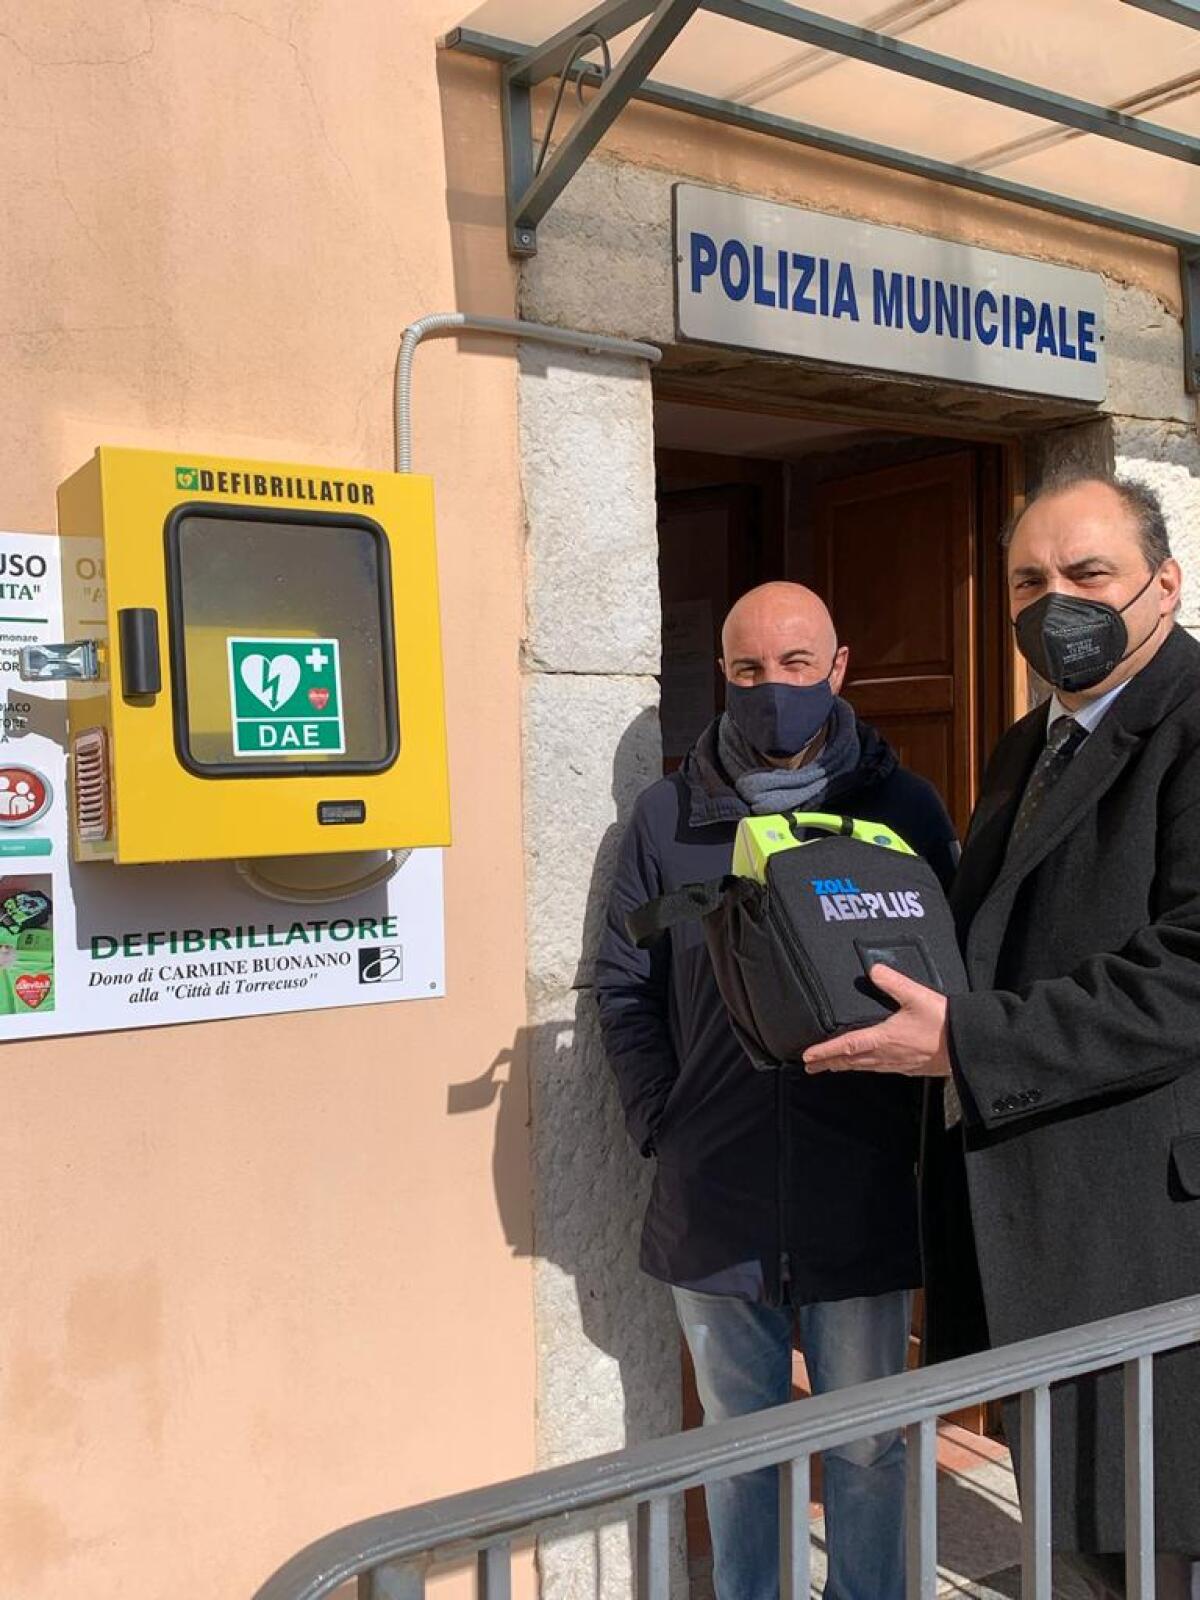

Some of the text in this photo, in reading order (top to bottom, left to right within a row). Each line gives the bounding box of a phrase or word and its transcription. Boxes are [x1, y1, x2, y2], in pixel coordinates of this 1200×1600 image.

[690, 232, 1097, 363] POLIZIA MUNICIPALE
[201, 470, 375, 505] DEFIBRILLATOR
[258, 724, 321, 747] DAE
[811, 879, 860, 895] ZOLL
[91, 916, 398, 960] DEFIBRILLATORE
[88, 970, 134, 988] Dono
[138, 967, 153, 983] di
[159, 959, 248, 982] CARMINE
[253, 951, 351, 973] BUONANNO
[129, 989, 159, 1004] alla
[216, 981, 230, 996] di
[235, 973, 318, 994] Torrecuso"
